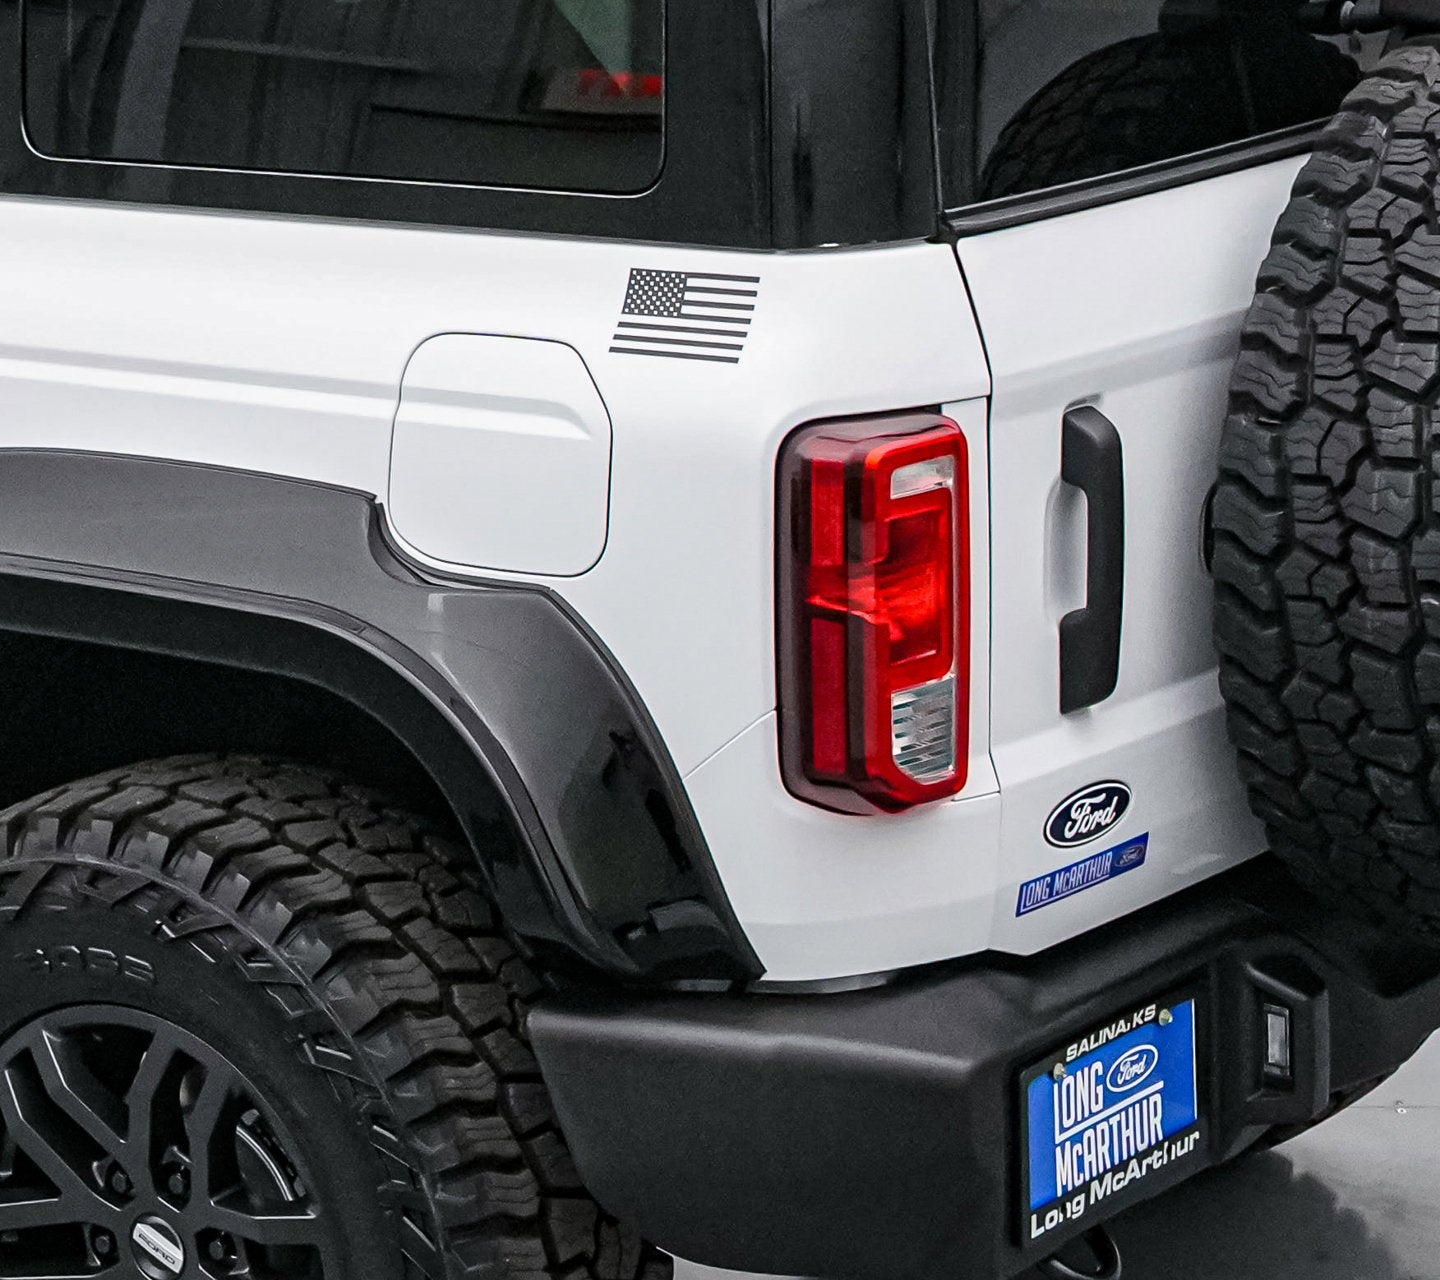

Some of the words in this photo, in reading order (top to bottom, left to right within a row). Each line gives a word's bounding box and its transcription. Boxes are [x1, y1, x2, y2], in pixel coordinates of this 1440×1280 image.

[1064, 792, 1118, 839] Ford
[1020, 876, 1050, 912] LONG
[1053, 851, 1113, 895] McARTHUR
[1132, 1004, 1156, 1027] KS
[1116, 1052, 1148, 1085] Ford
[1053, 1060, 1104, 1143] LONG
[1055, 1093, 1163, 1197] McARTHUR
[1031, 1193, 1085, 1239] Long
[1089, 1131, 1200, 1206] McArthur
[138, 1232, 176, 1266] FORD
